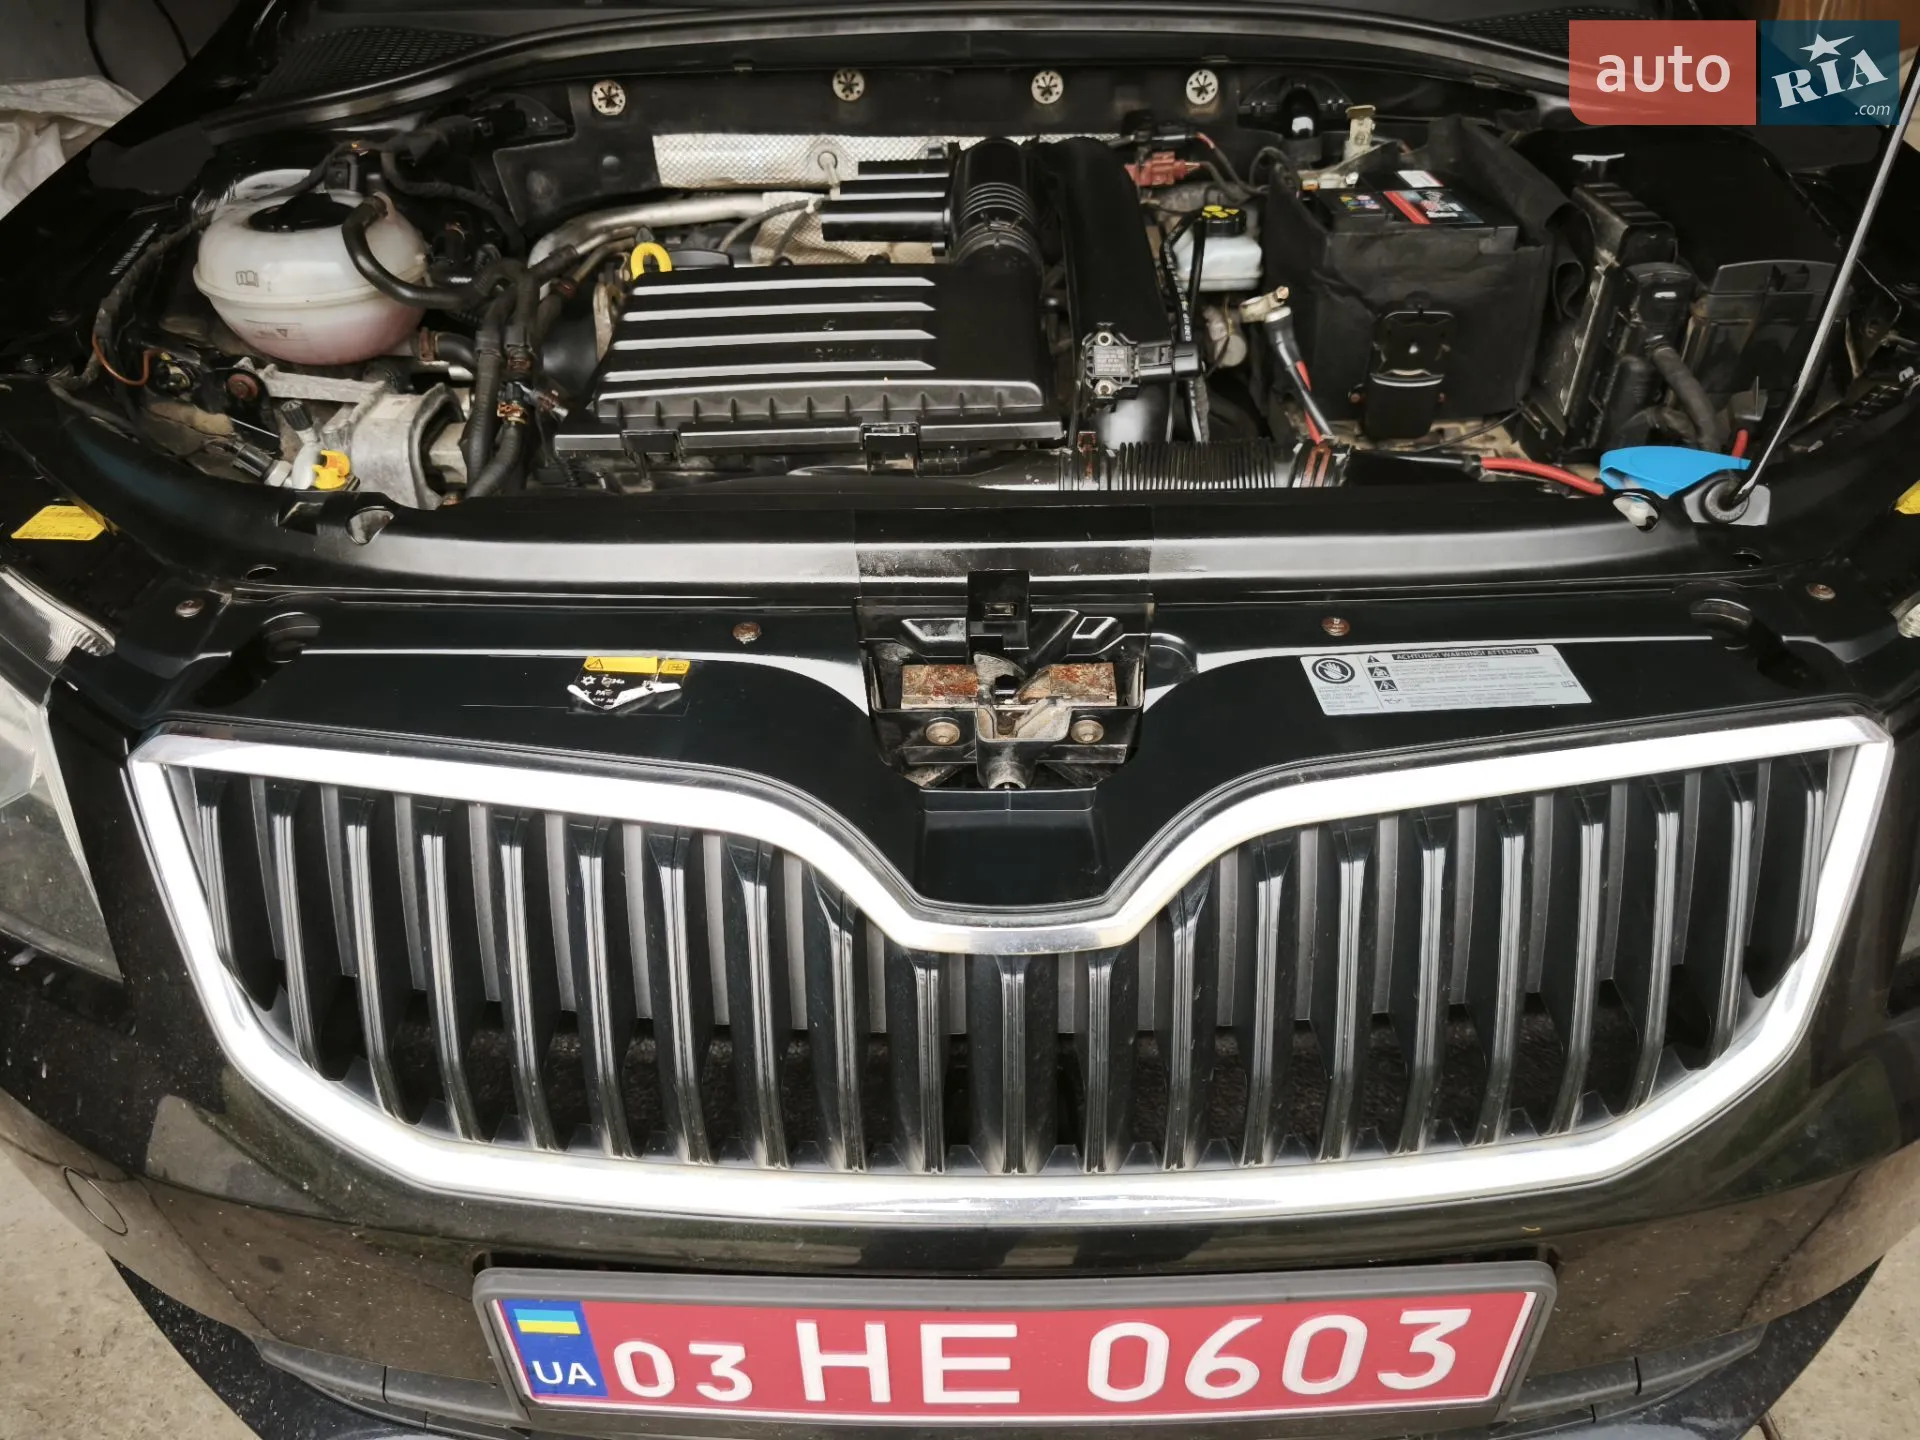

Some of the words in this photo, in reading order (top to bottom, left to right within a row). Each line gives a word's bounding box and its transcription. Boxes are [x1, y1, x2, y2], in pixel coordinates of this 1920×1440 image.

[1395, 651, 1441, 660] ACHTUNG!
[1442, 650, 1486, 659] WARNING!
[1487, 648, 1537, 657] ATTENTION!
[613, 1340, 753, 1402] 03
[796, 1319, 1020, 1403] HE
[1087, 1308, 1472, 1402] 0603
[532, 1360, 597, 1387] UA
